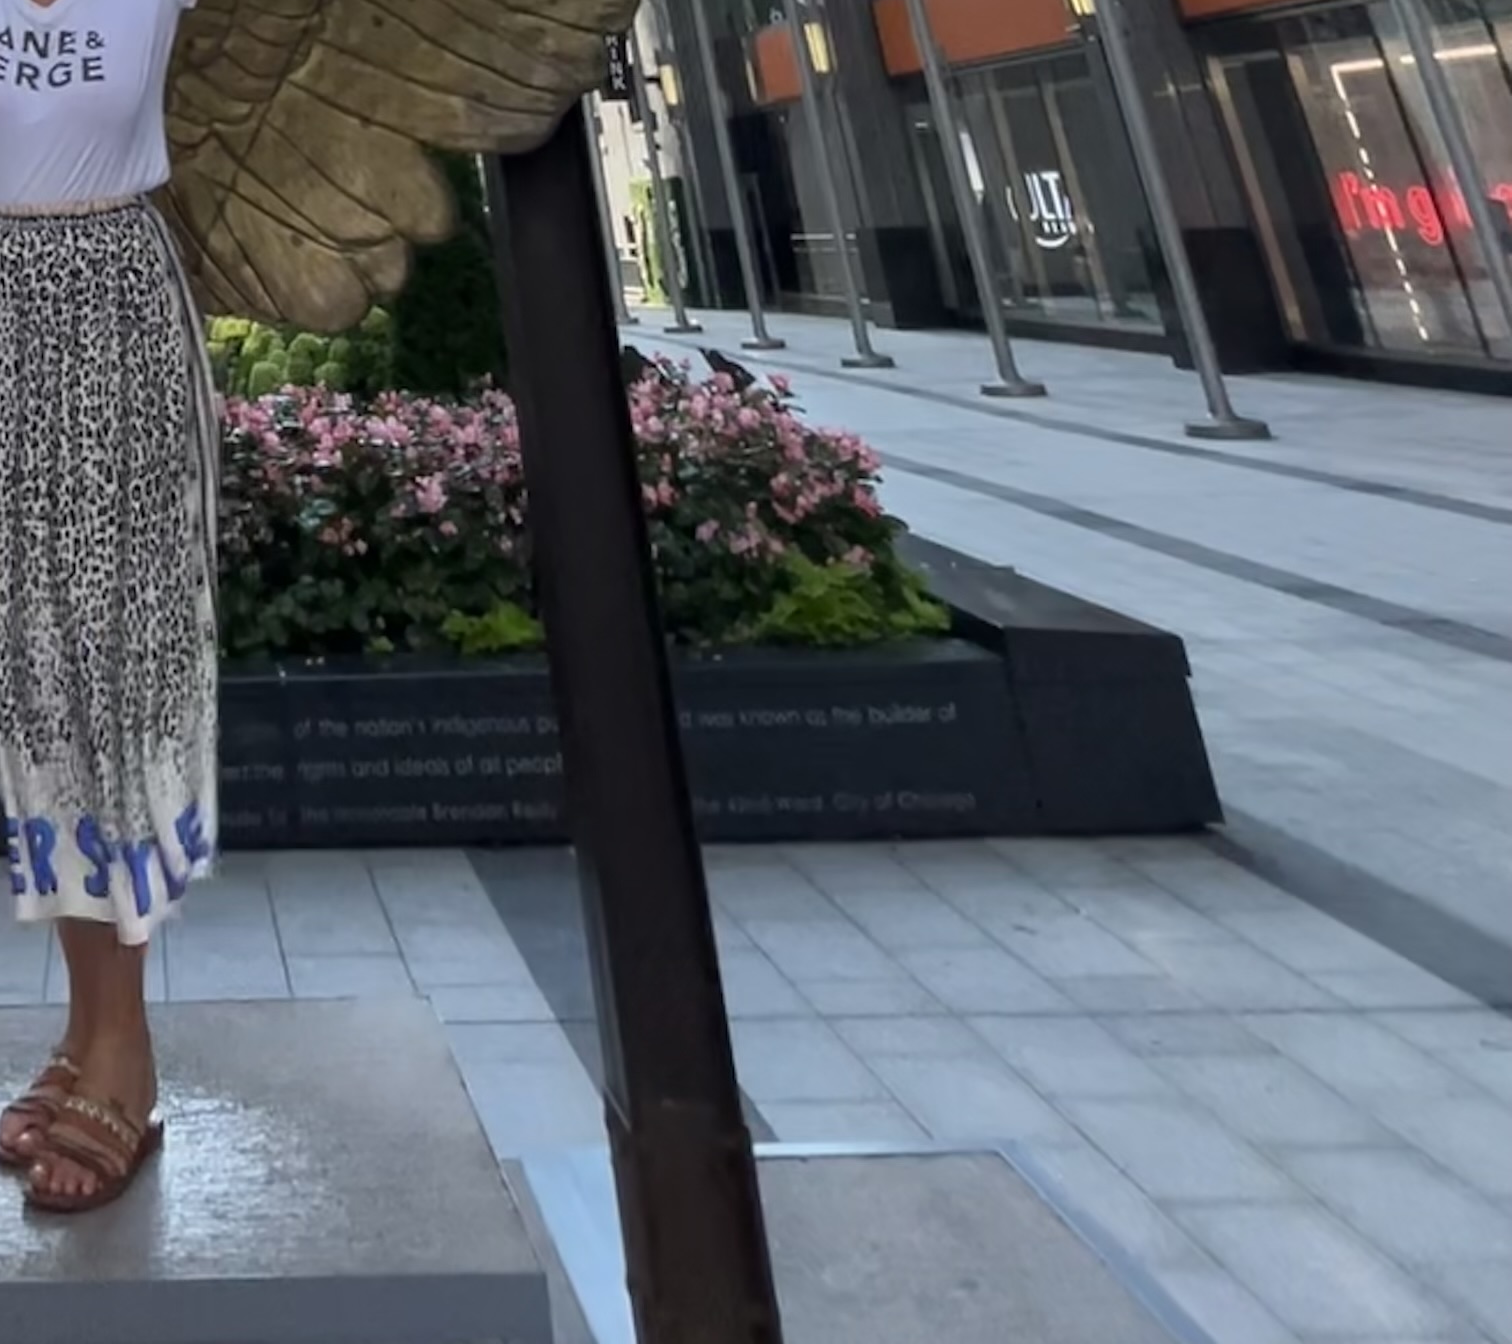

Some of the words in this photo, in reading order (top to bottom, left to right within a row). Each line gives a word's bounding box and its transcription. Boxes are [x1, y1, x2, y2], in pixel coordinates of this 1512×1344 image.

[85, 30, 106, 51] &
[738, 708, 801, 728] known
[867, 701, 932, 725] builder
[351, 757, 391, 779] and
[393, 754, 451, 777] ideals
[505, 751, 564, 779] peopl
